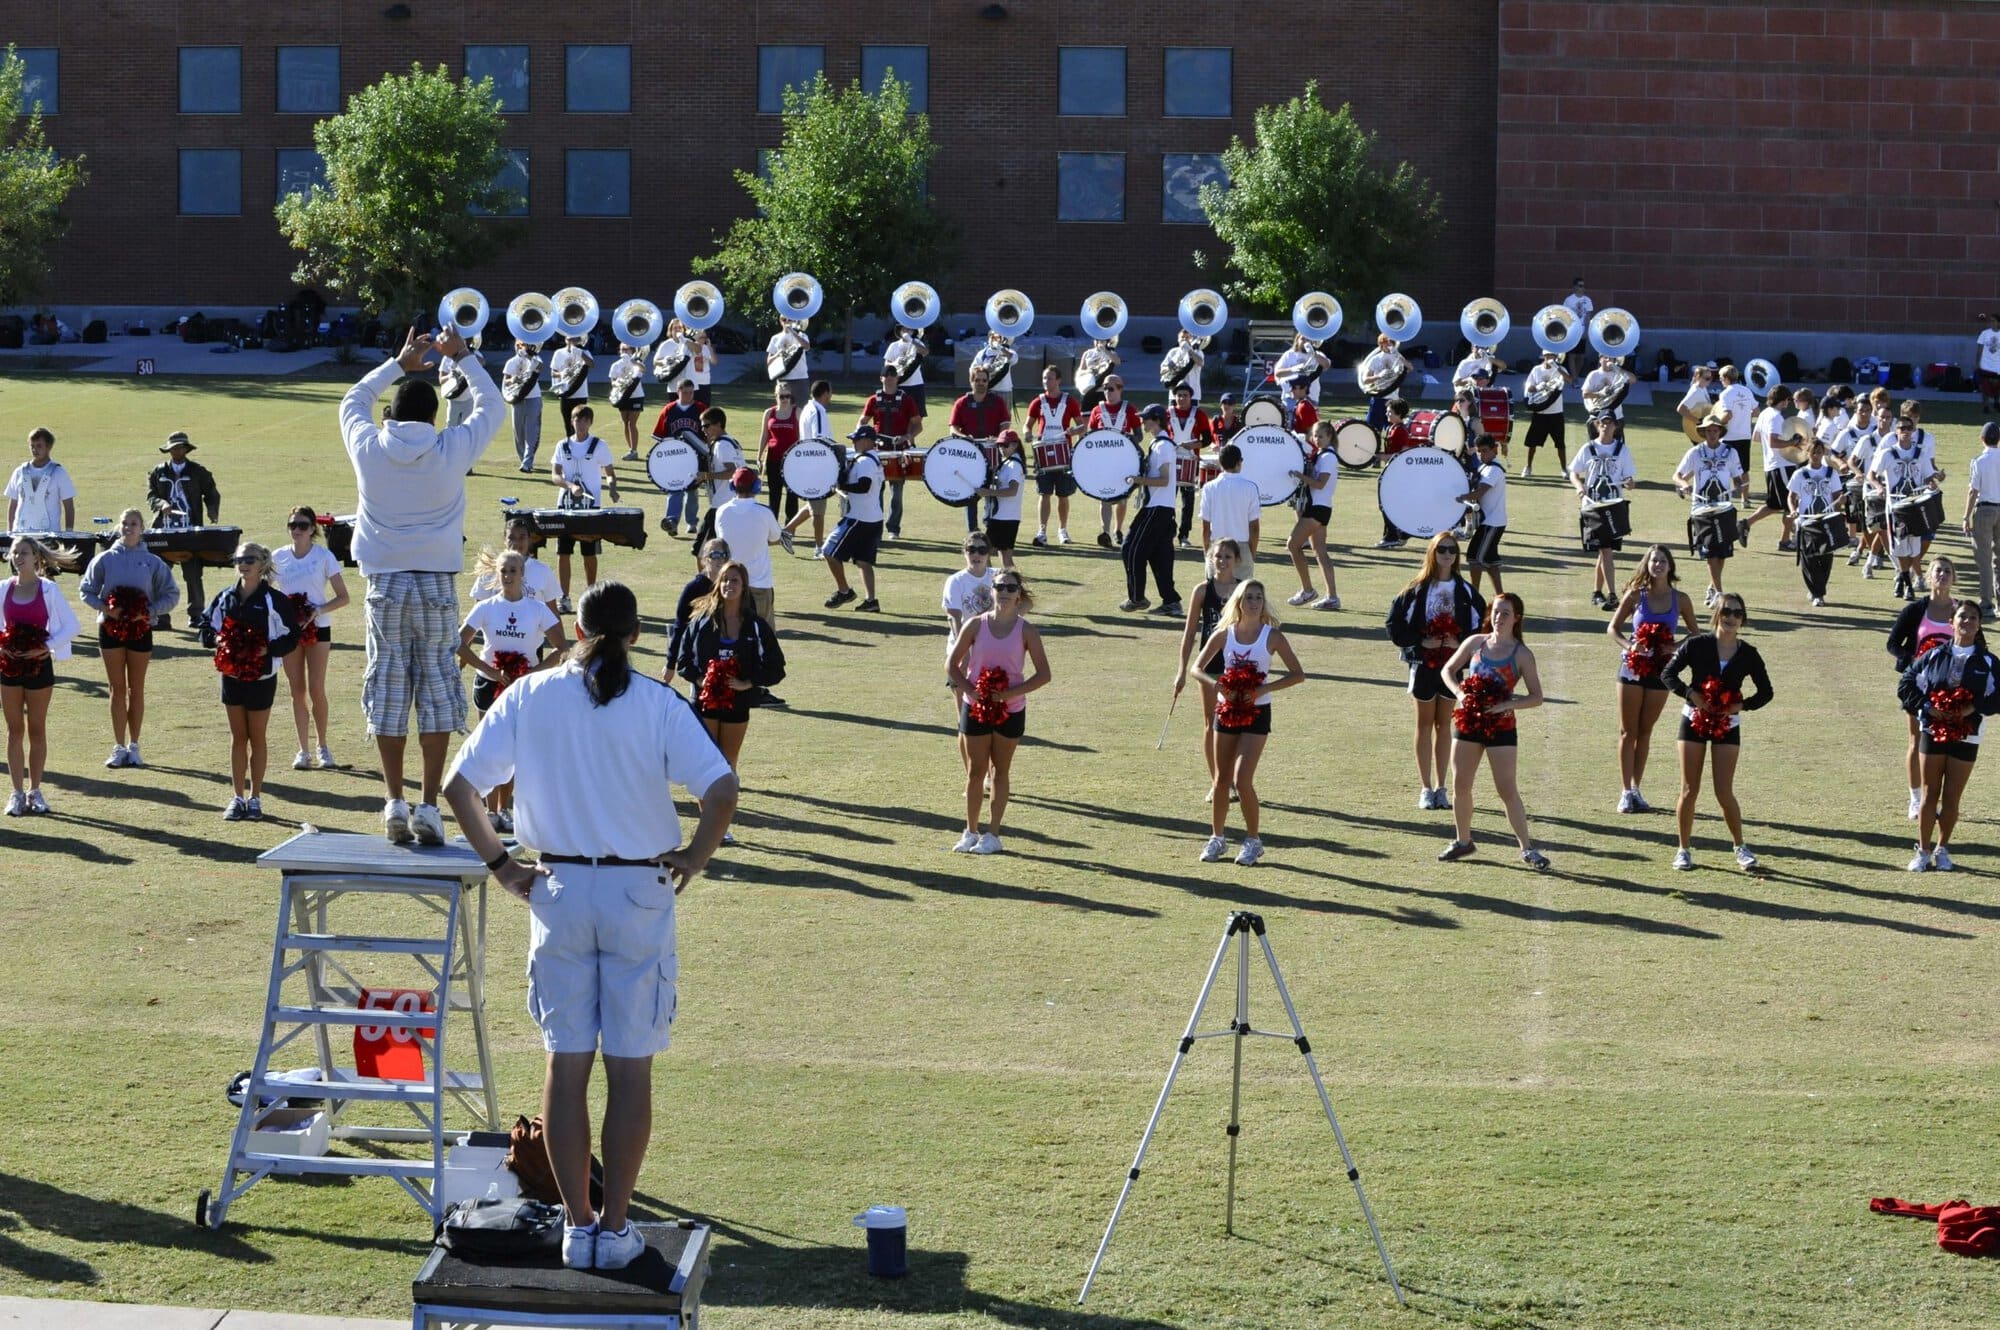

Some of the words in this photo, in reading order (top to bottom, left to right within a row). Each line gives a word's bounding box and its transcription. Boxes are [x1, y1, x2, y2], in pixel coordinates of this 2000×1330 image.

[138, 360, 153, 375] 30
[1265, 360, 1274, 375] 5
[1094, 439, 1125, 449] YAMAHA
[1255, 435, 1285, 445] YAMAHA
[664, 447, 688, 457] YAMAHA
[802, 449, 827, 457] YAMAHA
[947, 447, 977, 460] YAMAHA
[1414, 456, 1444, 465] YAMAHA
[495, 629, 527, 639] MOMMY
[360, 991, 422, 1043] 50
